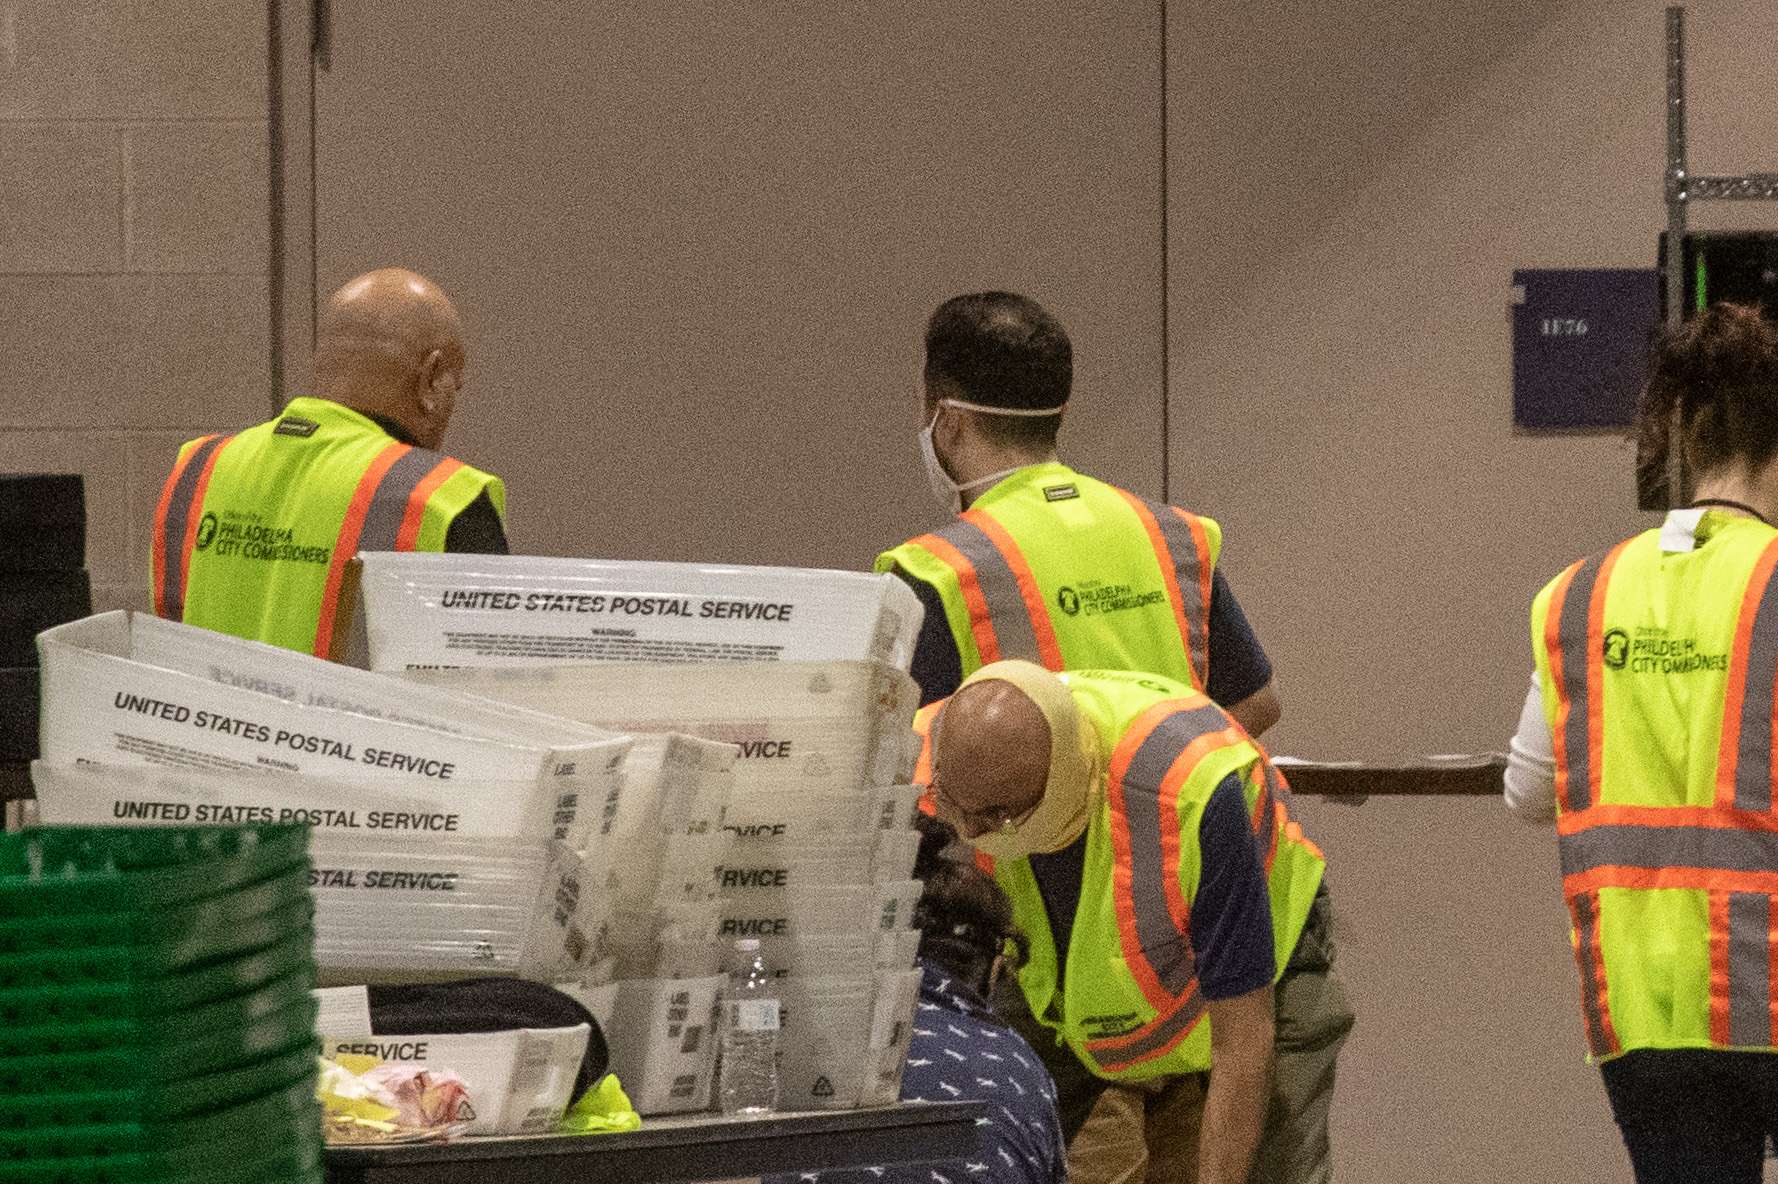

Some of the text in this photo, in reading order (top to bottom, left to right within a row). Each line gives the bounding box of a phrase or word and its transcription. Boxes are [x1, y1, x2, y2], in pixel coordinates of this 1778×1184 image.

[442, 590, 794, 622] UNITED STATES POSTAL SERVICE
[113, 691, 191, 725] UNITED
[193, 709, 271, 743] STATES
[274, 730, 356, 761] POSTAL
[361, 747, 456, 780] SERVICE
[737, 741, 792, 759] VICE
[112, 800, 460, 832] UNITED STATES POSTAL SERVICE
[309, 869, 460, 891] STAL SERVICE
[721, 867, 788, 888] RVICE
[720, 917, 790, 936] RVICE
